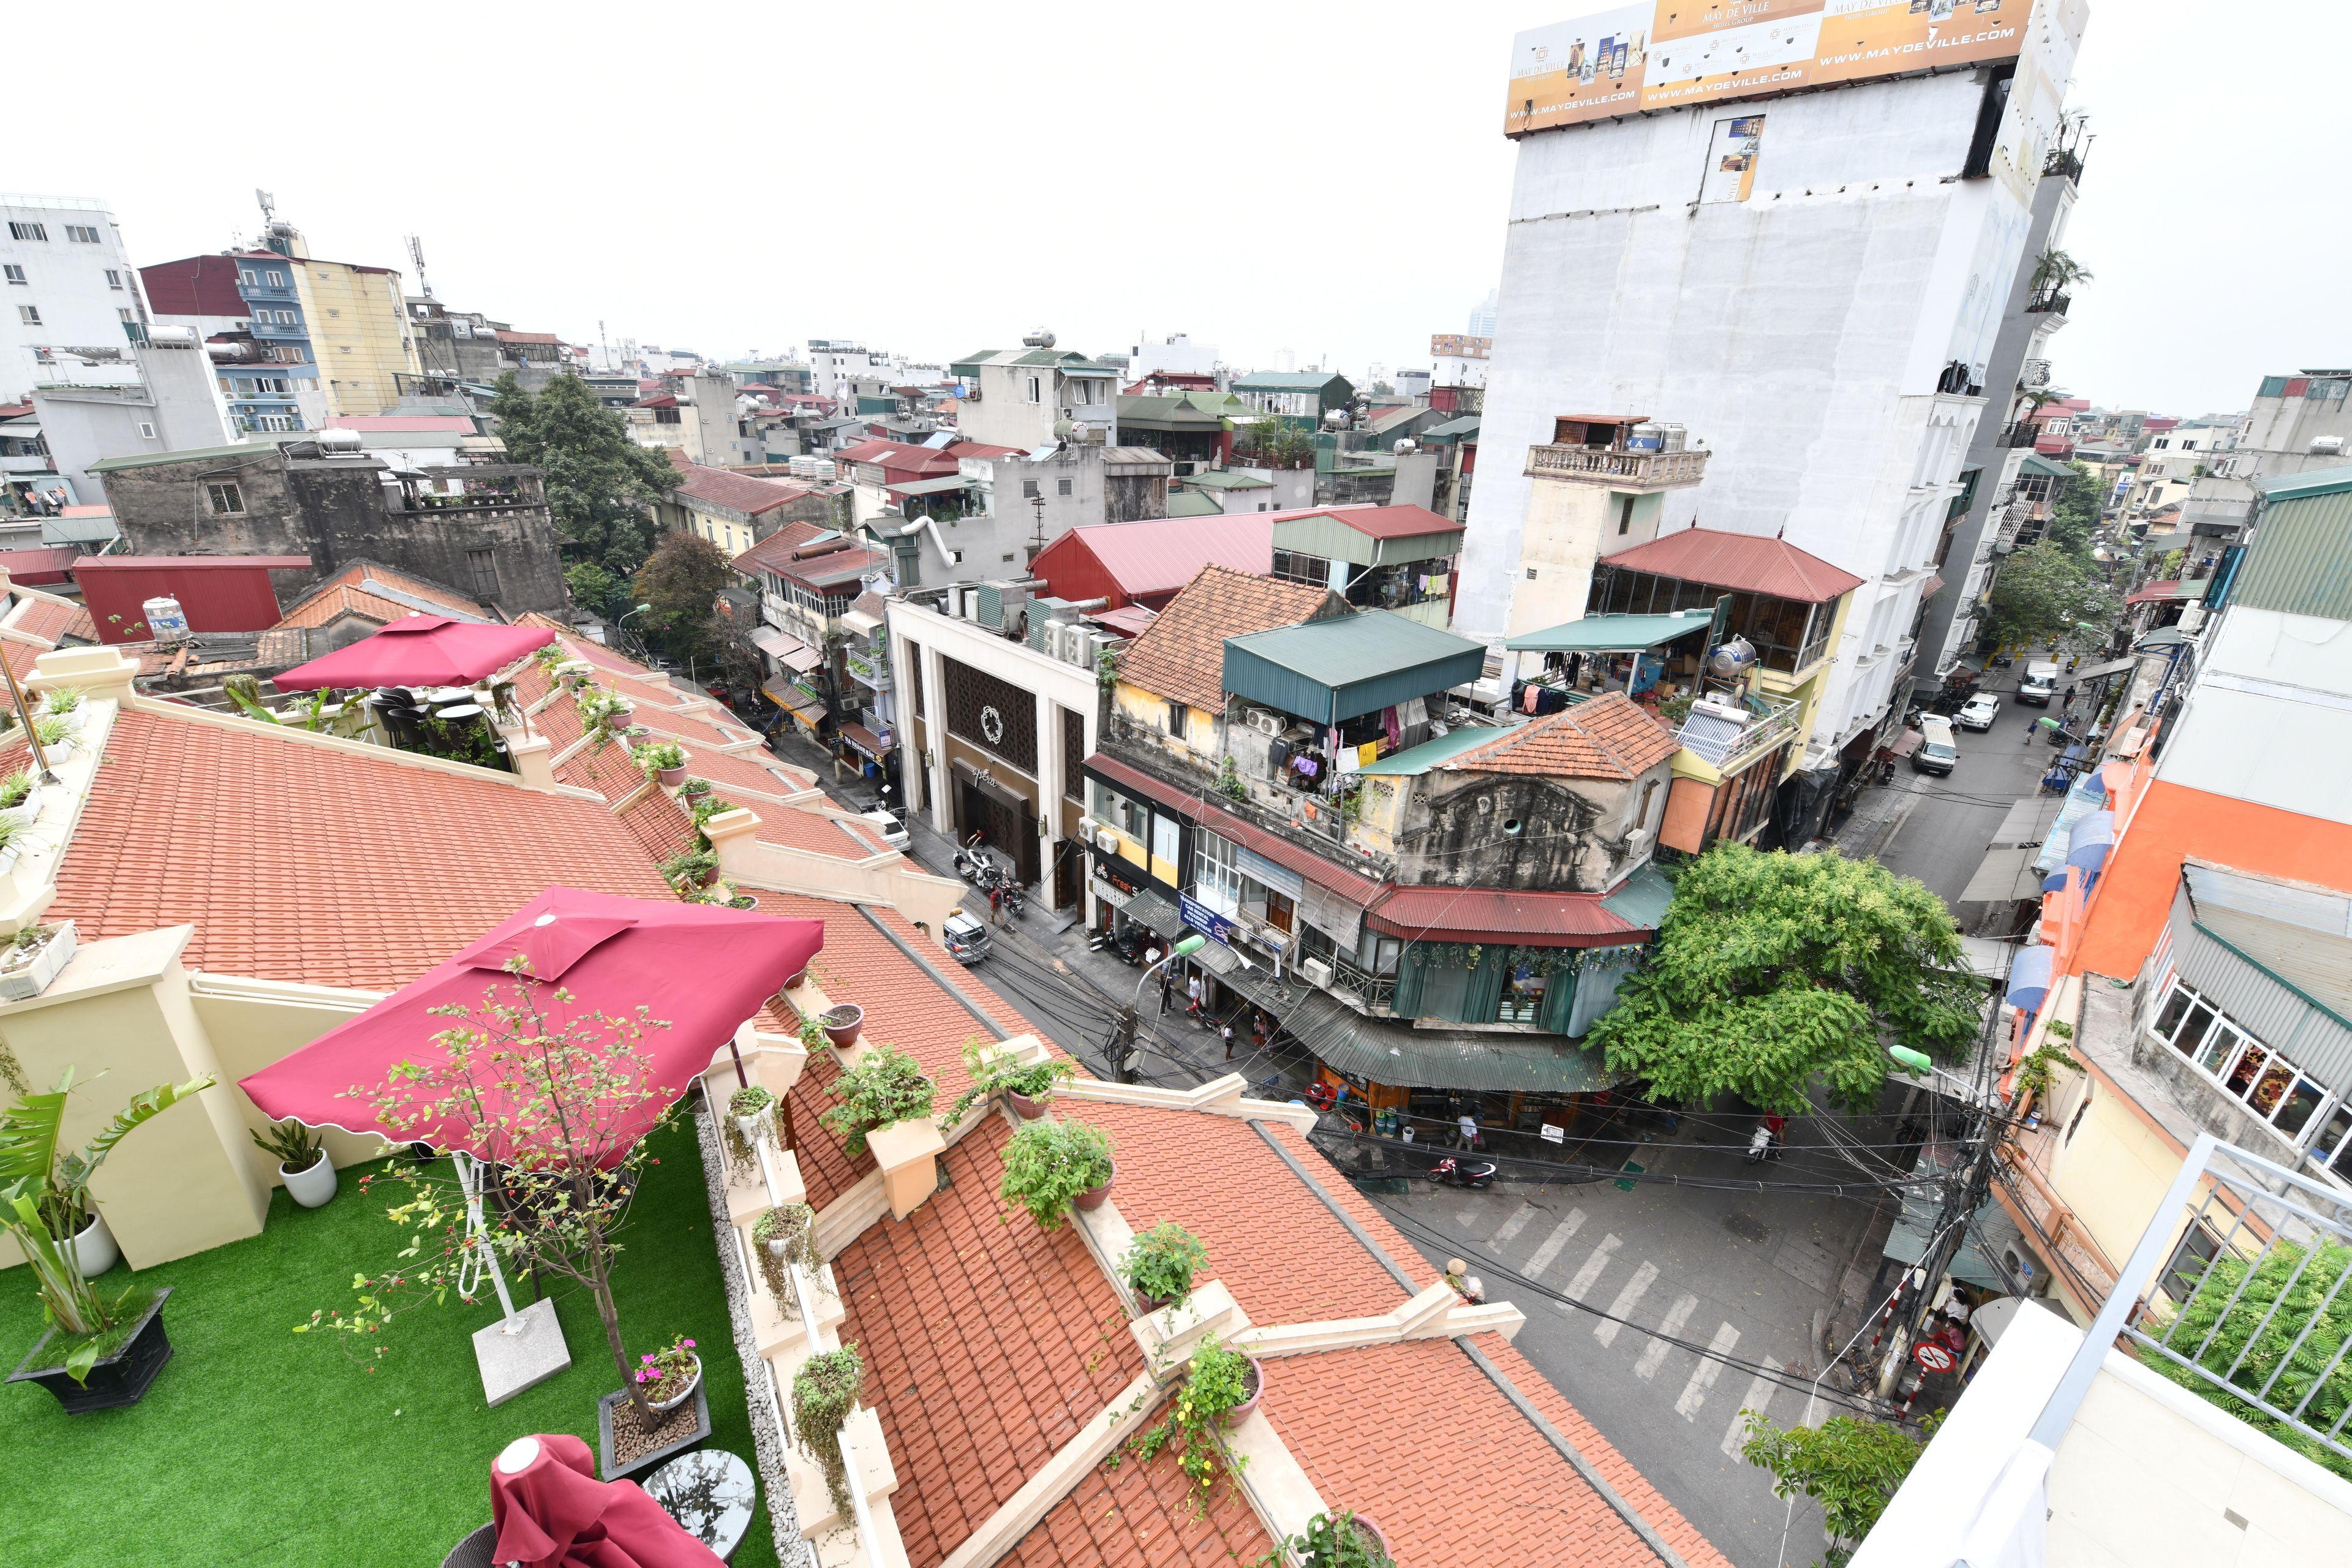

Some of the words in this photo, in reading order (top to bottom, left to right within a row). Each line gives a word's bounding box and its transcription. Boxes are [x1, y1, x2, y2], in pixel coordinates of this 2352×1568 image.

[1703, 10, 1725, 23] MAY
[1727, 9, 1741, 18] DE
[1743, 1, 1770, 16] VILLE
[1834, 3, 1856, 13] MAY
[1732, 16, 1754, 25] GROUP
[1820, 28, 2015, 66] WWW.MAYDEVILLE.COM
[1517, 67, 1533, 77] MAY
[1546, 61, 1564, 71] VILLE
[1648, 70, 1802, 101] WWW.MAYDEVILLE.COM
[1510, 90, 1635, 119] WWW.MAYDEVILLE.COM
[973, 768, 998, 788] opera
[1112, 875, 1131, 893] Fresh
[1180, 895, 1215, 919] TRANSPORTATION
[1185, 903, 1194, 913] CAR
[1194, 908, 1209, 921] RENTAL
[1194, 918, 1212, 933] VIETNAM
